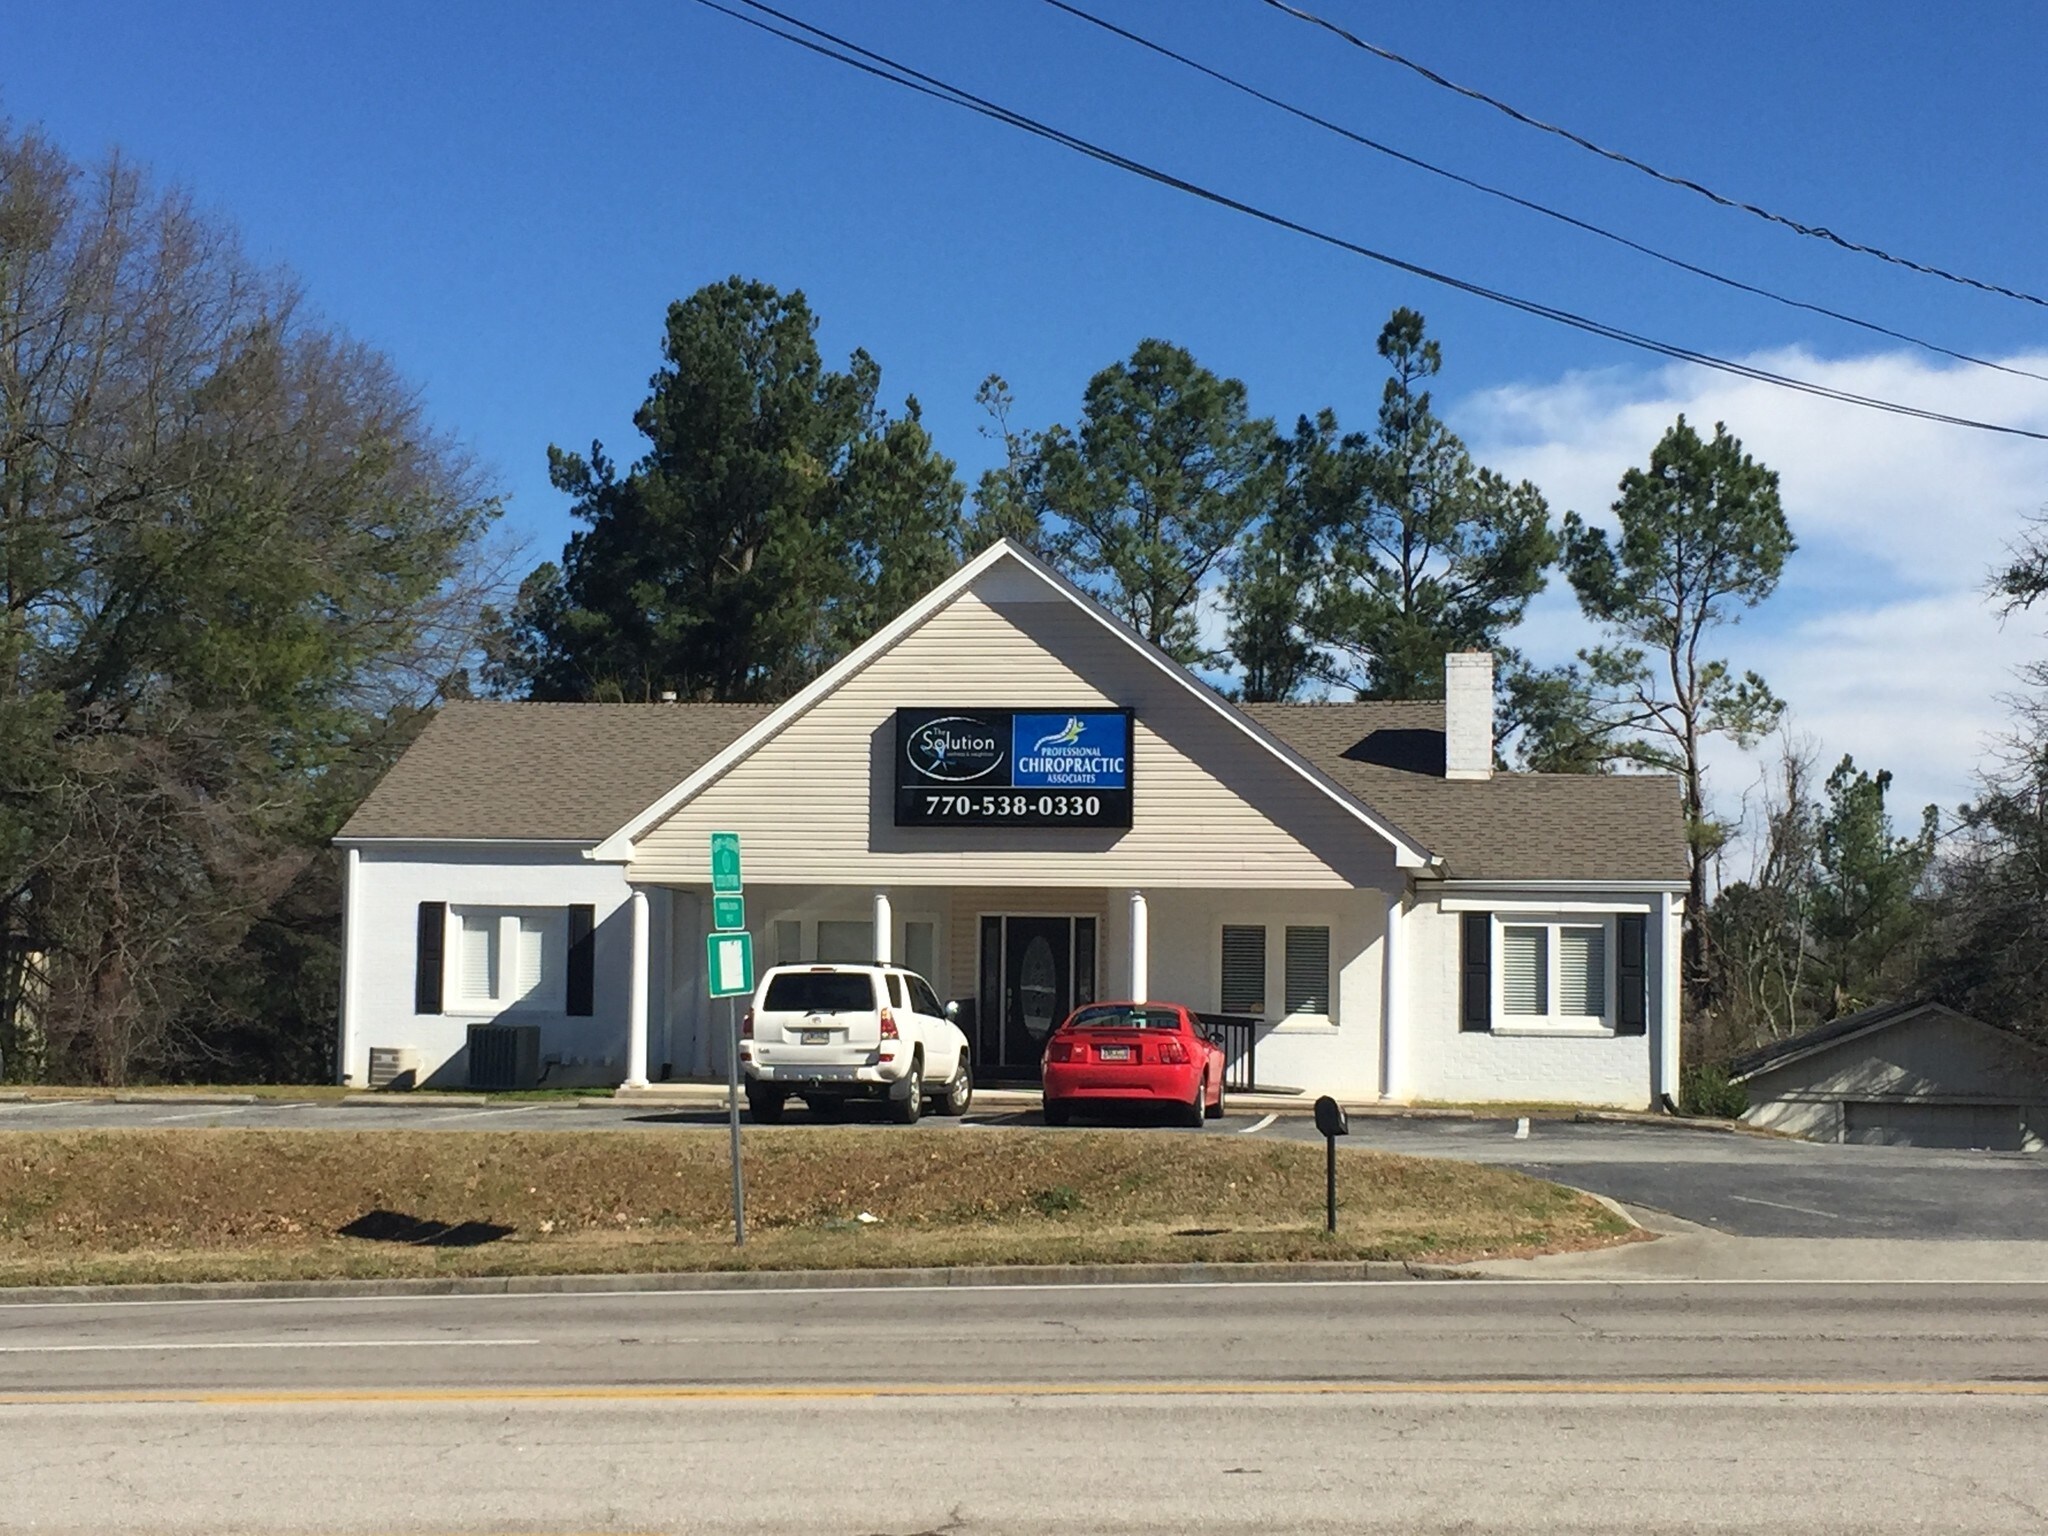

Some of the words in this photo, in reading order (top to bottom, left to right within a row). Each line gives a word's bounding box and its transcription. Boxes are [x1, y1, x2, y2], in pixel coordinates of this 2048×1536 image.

[933, 727, 946, 736] The
[923, 731, 995, 750] Solution
[1041, 747, 1102, 757] PROFESSIONAL
[1018, 757, 1125, 773] CHIROPRACTIC
[1047, 773, 1096, 784] ASSOCIATES
[926, 796, 1101, 816] 770-538-0330
